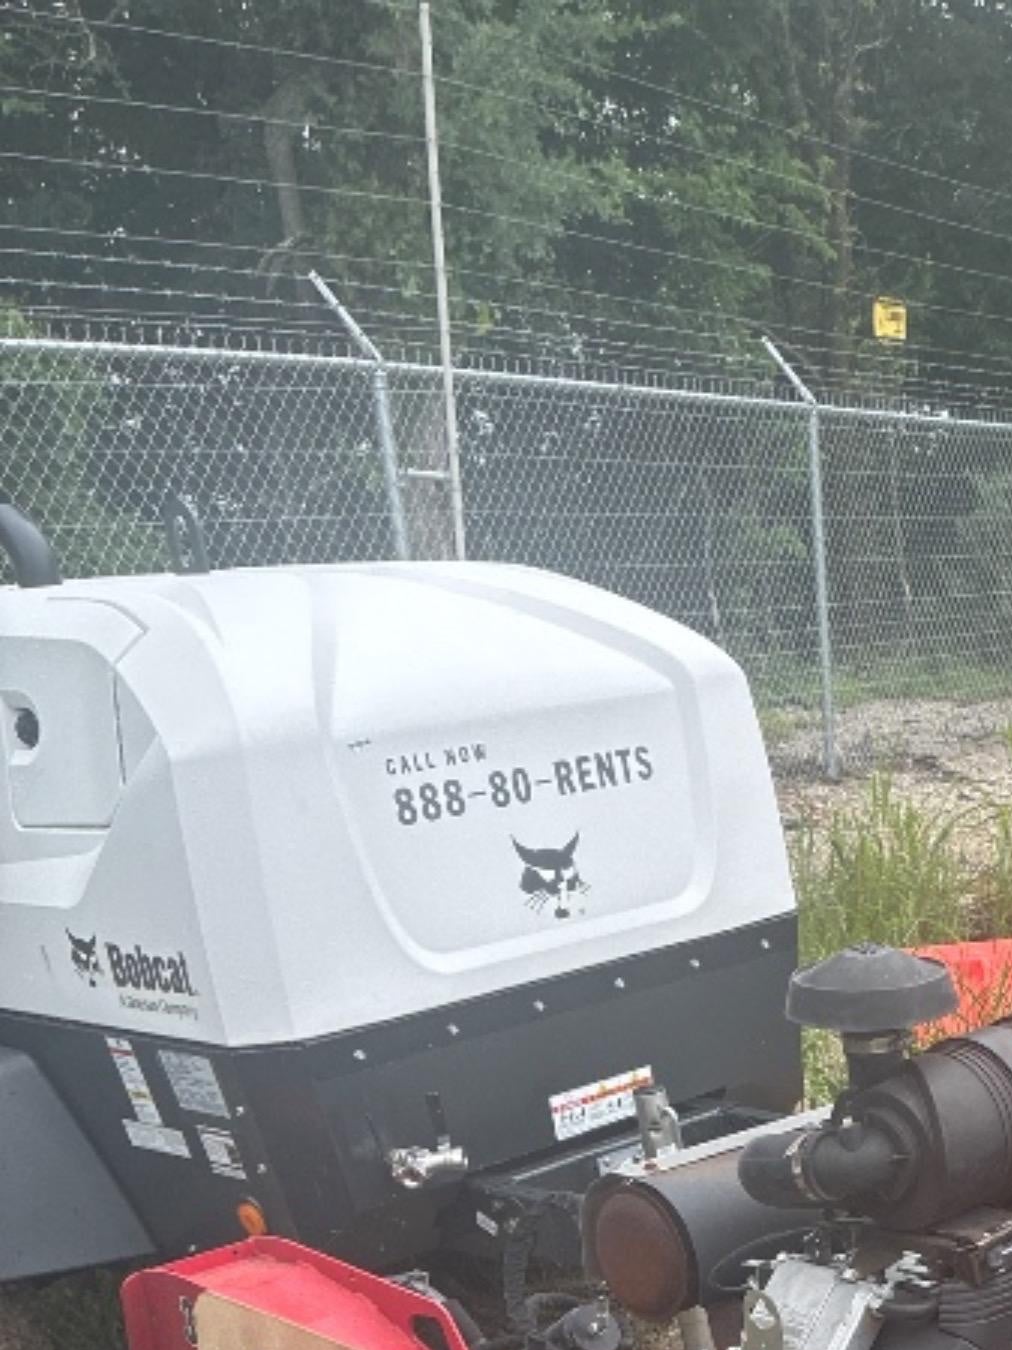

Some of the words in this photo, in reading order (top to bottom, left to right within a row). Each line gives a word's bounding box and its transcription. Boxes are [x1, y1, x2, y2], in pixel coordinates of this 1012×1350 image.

[385, 752, 436, 776] CALL
[443, 742, 488, 767] NOW
[393, 745, 655, 826] 888-80-RENTS
[104, 941, 196, 997] Bobcat
